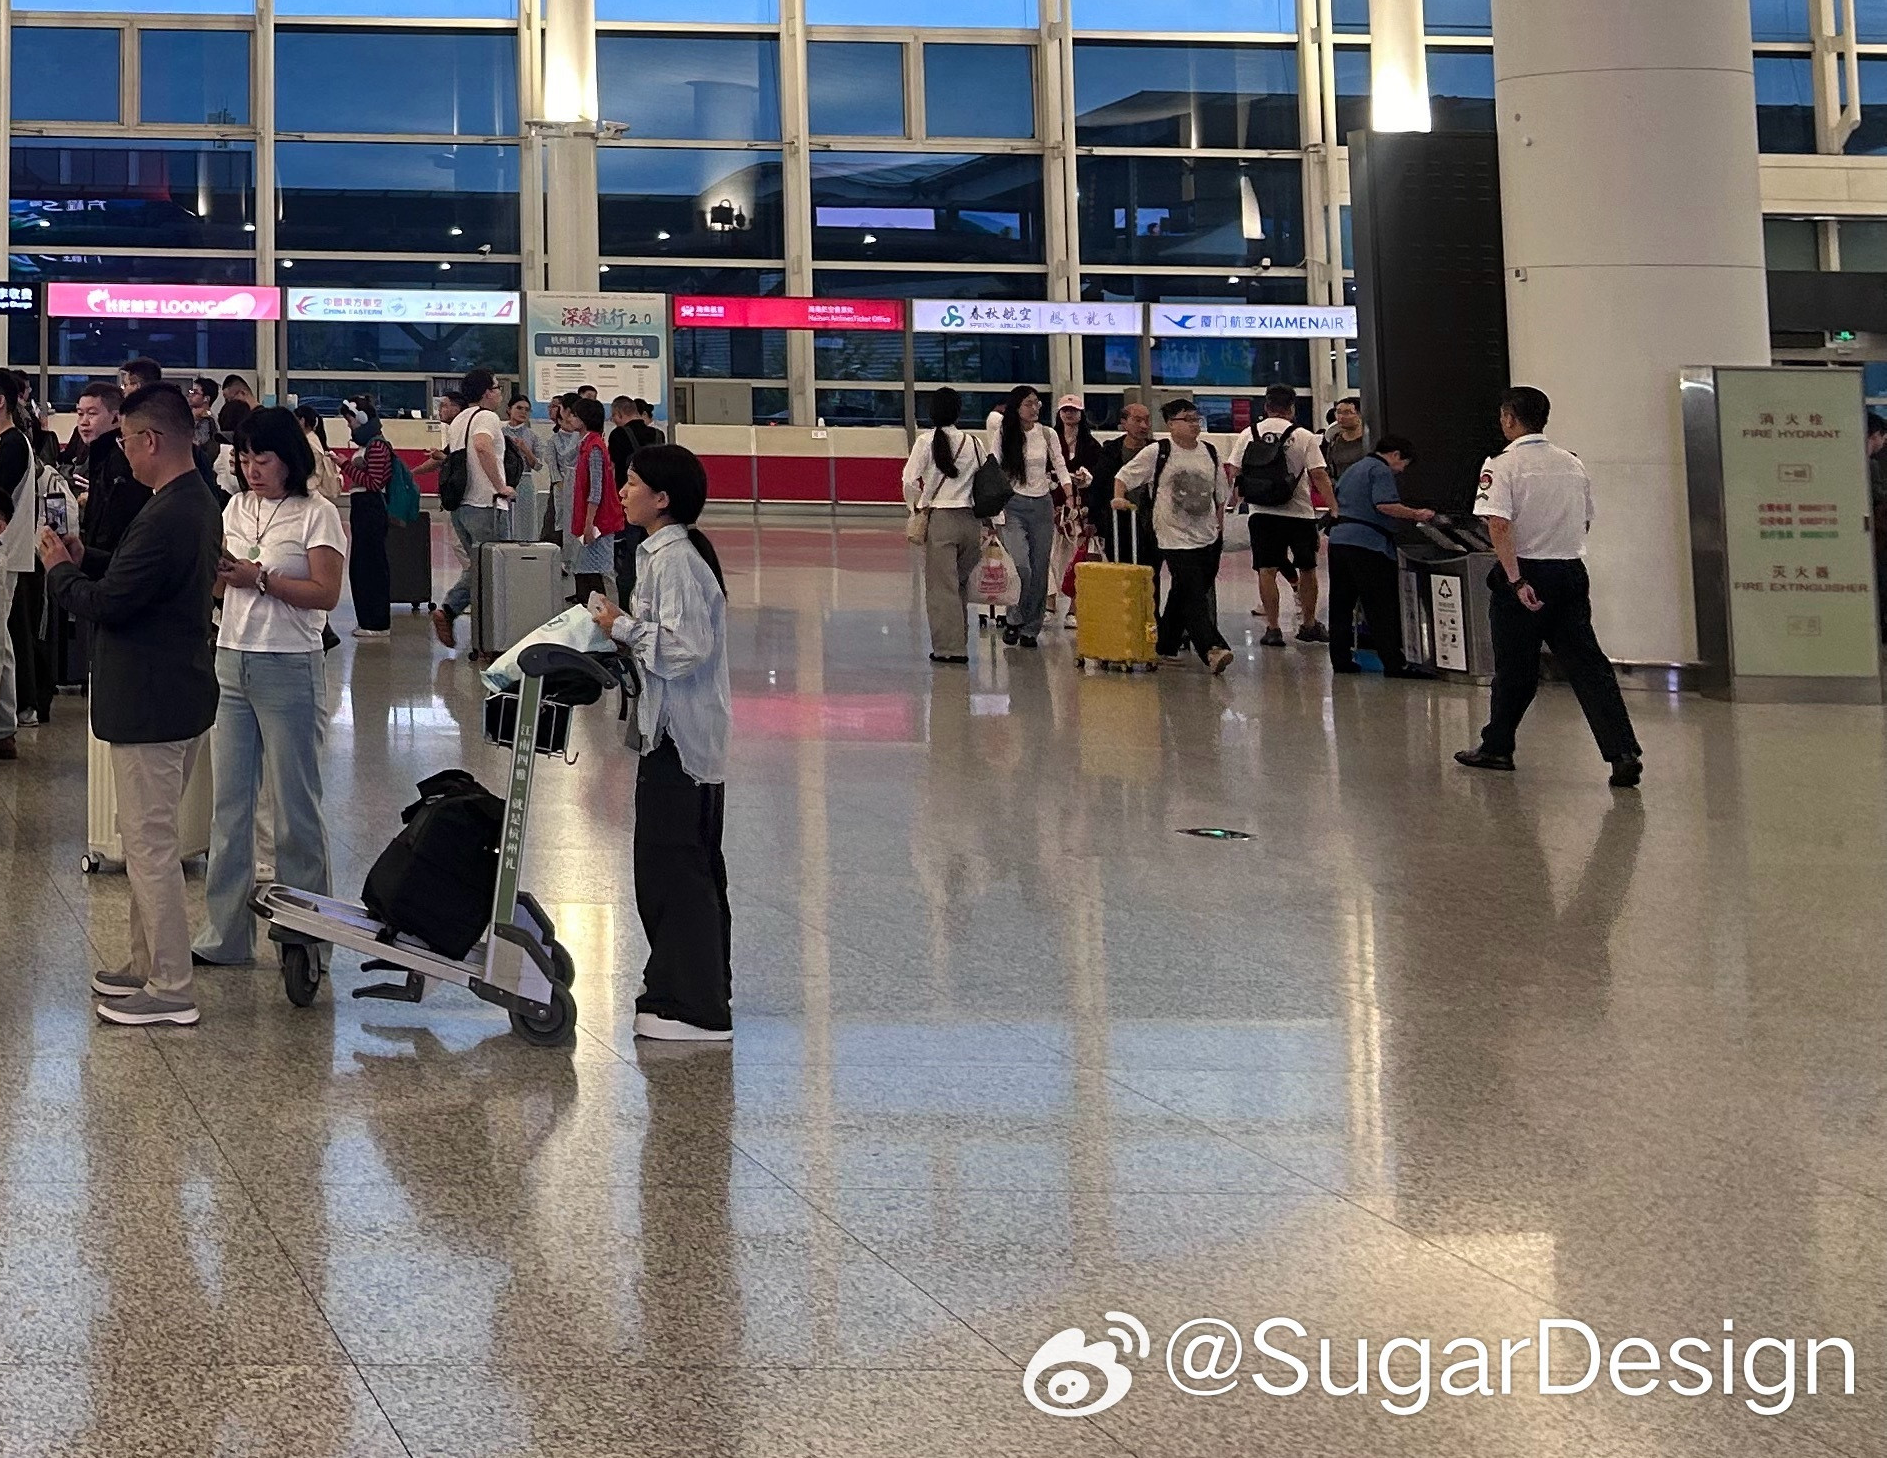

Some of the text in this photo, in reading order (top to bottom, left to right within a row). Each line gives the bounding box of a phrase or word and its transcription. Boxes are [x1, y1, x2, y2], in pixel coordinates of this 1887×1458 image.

[348, 308, 383, 316] EASTERN
[969, 305, 1032, 321] 春秋航空
[1201, 315, 1256, 329] 厦门航空
[1759, 413, 1823, 426] 消火栓
[1742, 429, 1841, 439] FIRE HYDRANT
[1772, 565, 1829, 580] 灭火器
[1734, 582, 1869, 593] FIRE EXTINGUISHER
